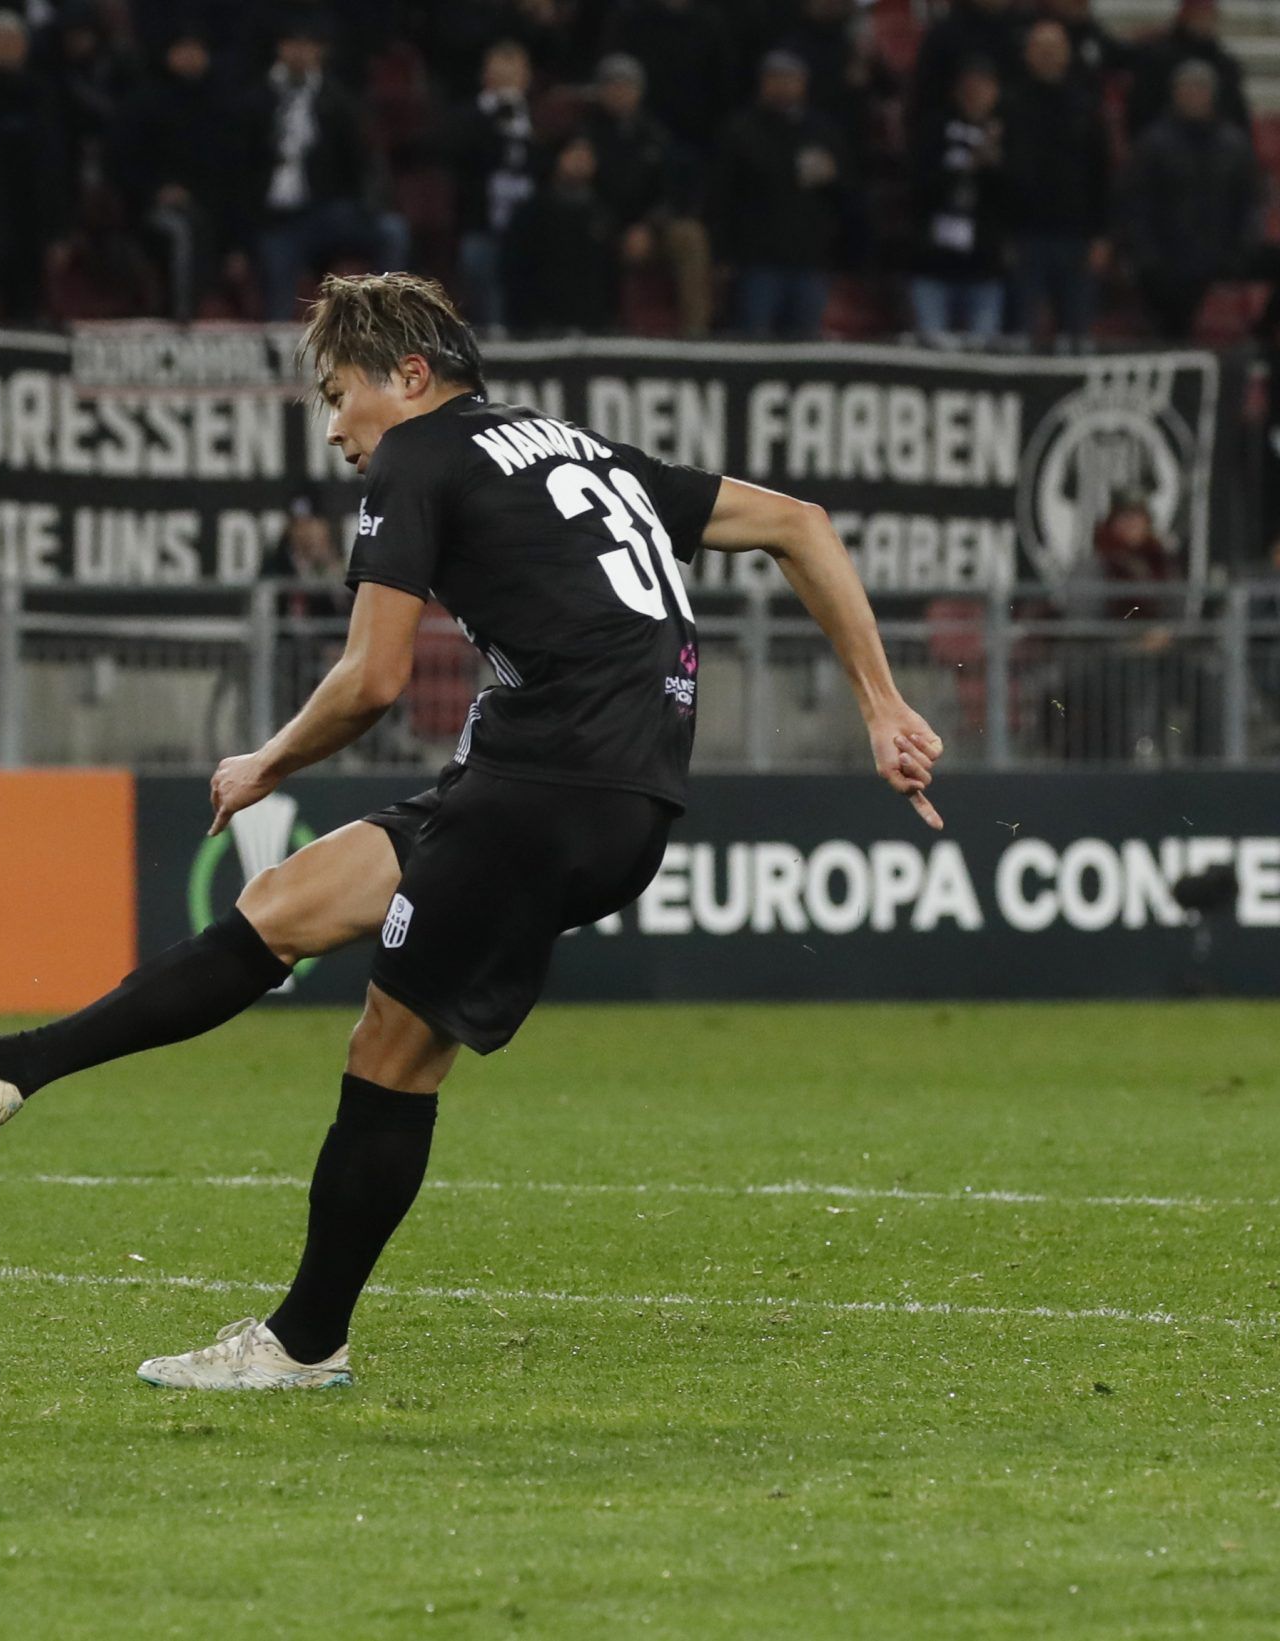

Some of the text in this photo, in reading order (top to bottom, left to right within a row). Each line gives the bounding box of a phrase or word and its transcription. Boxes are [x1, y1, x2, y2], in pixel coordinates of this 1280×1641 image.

[748, 380, 1019, 486] FARBEN
[74, 504, 204, 586] UNS
[637, 839, 984, 936] EUROPA
